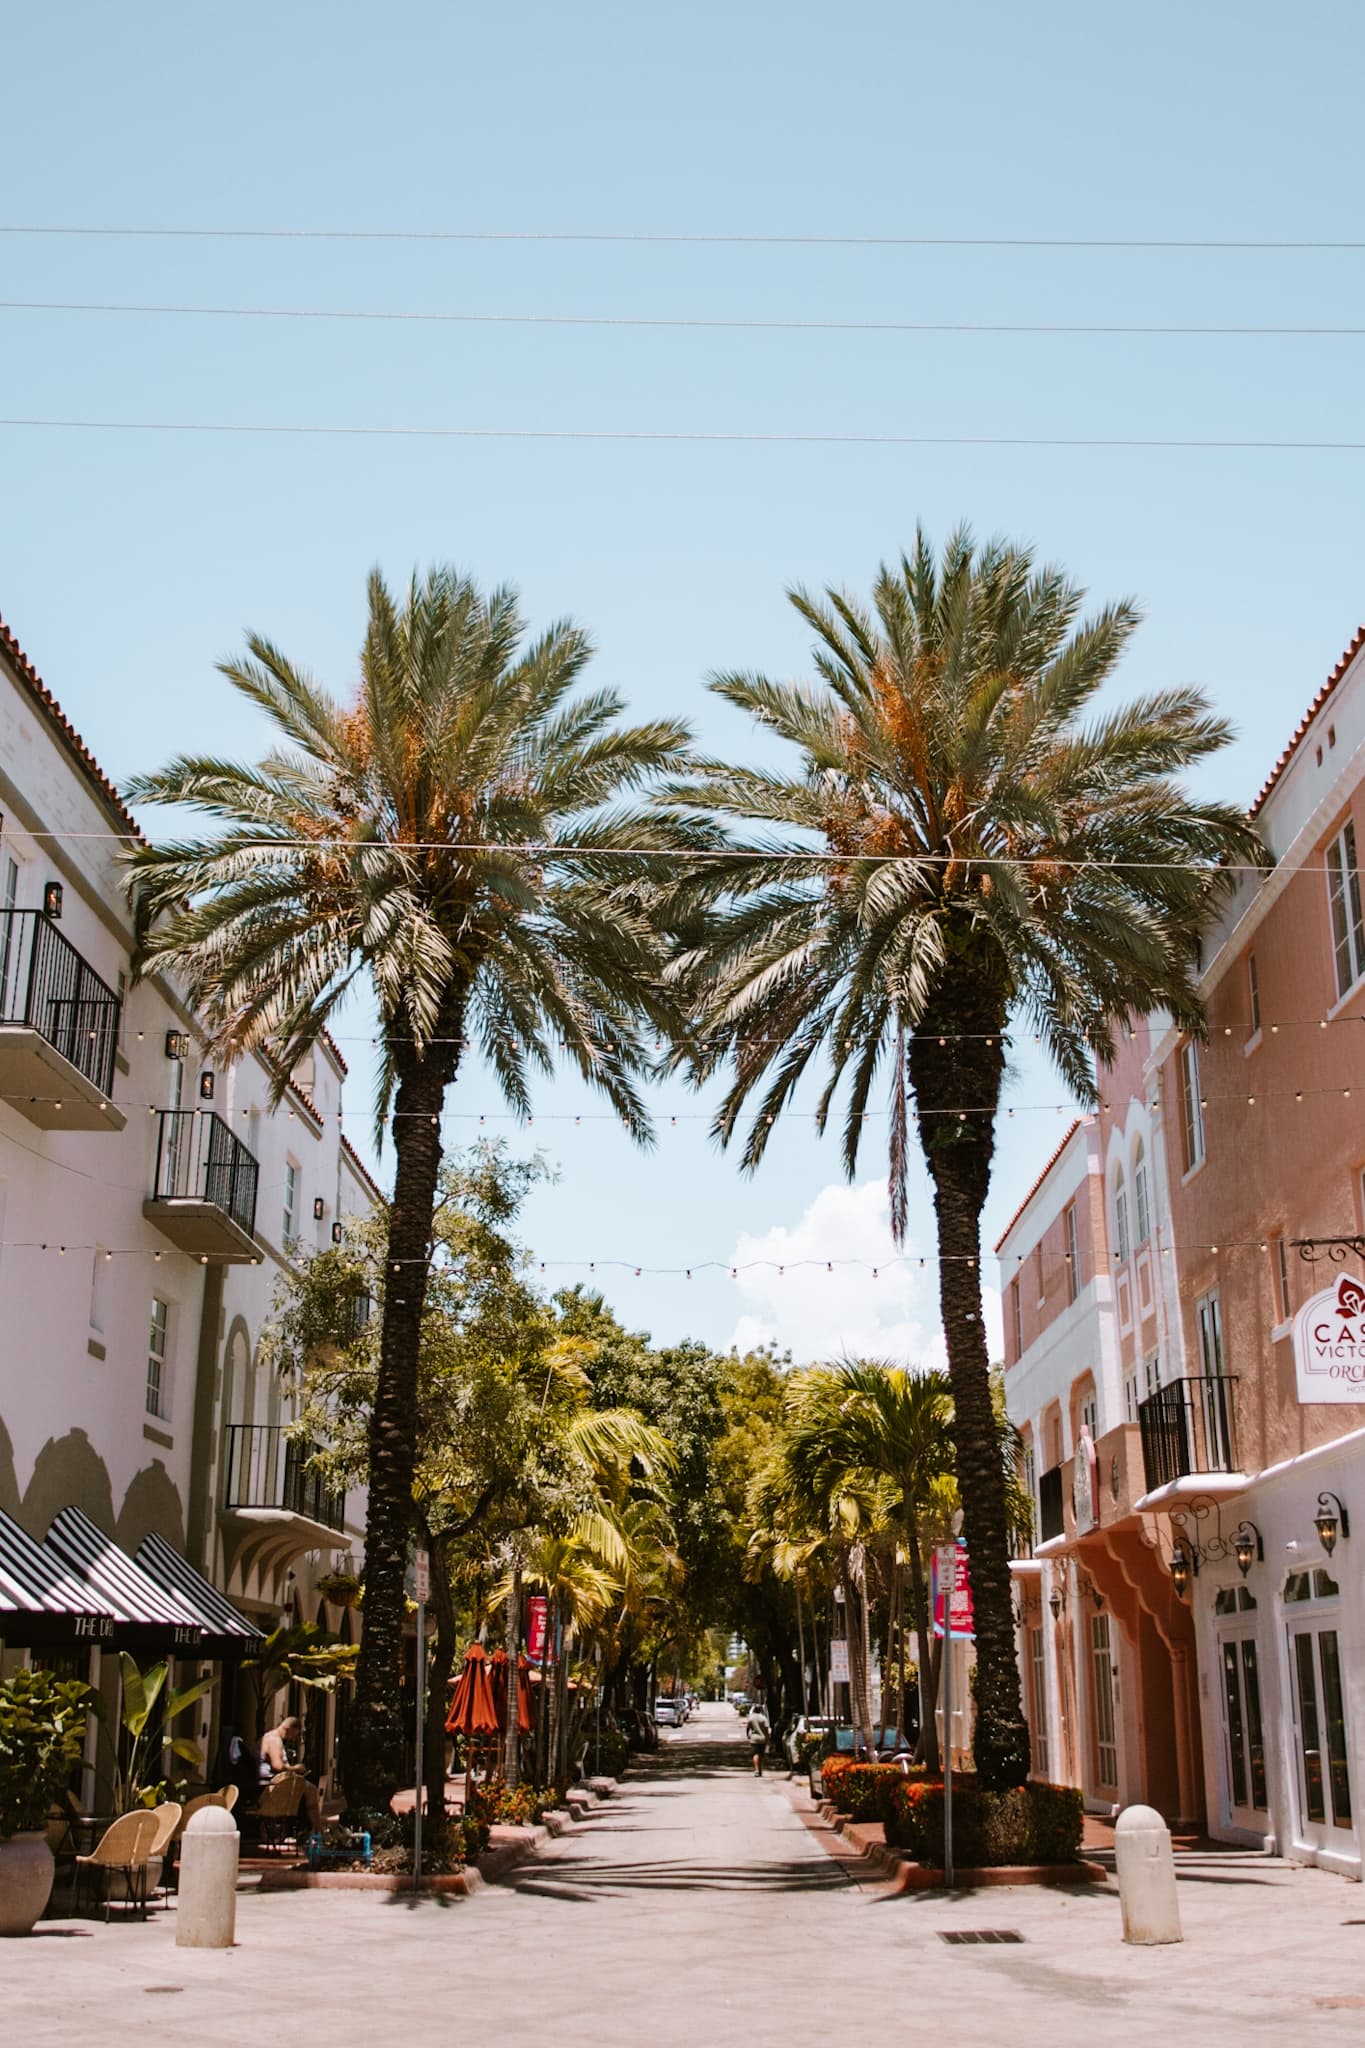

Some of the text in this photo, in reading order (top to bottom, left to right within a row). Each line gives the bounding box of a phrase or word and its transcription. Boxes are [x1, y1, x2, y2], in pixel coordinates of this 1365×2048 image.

[74, 1617, 113, 1637] THE DR
[174, 1627, 192, 1644] THE
